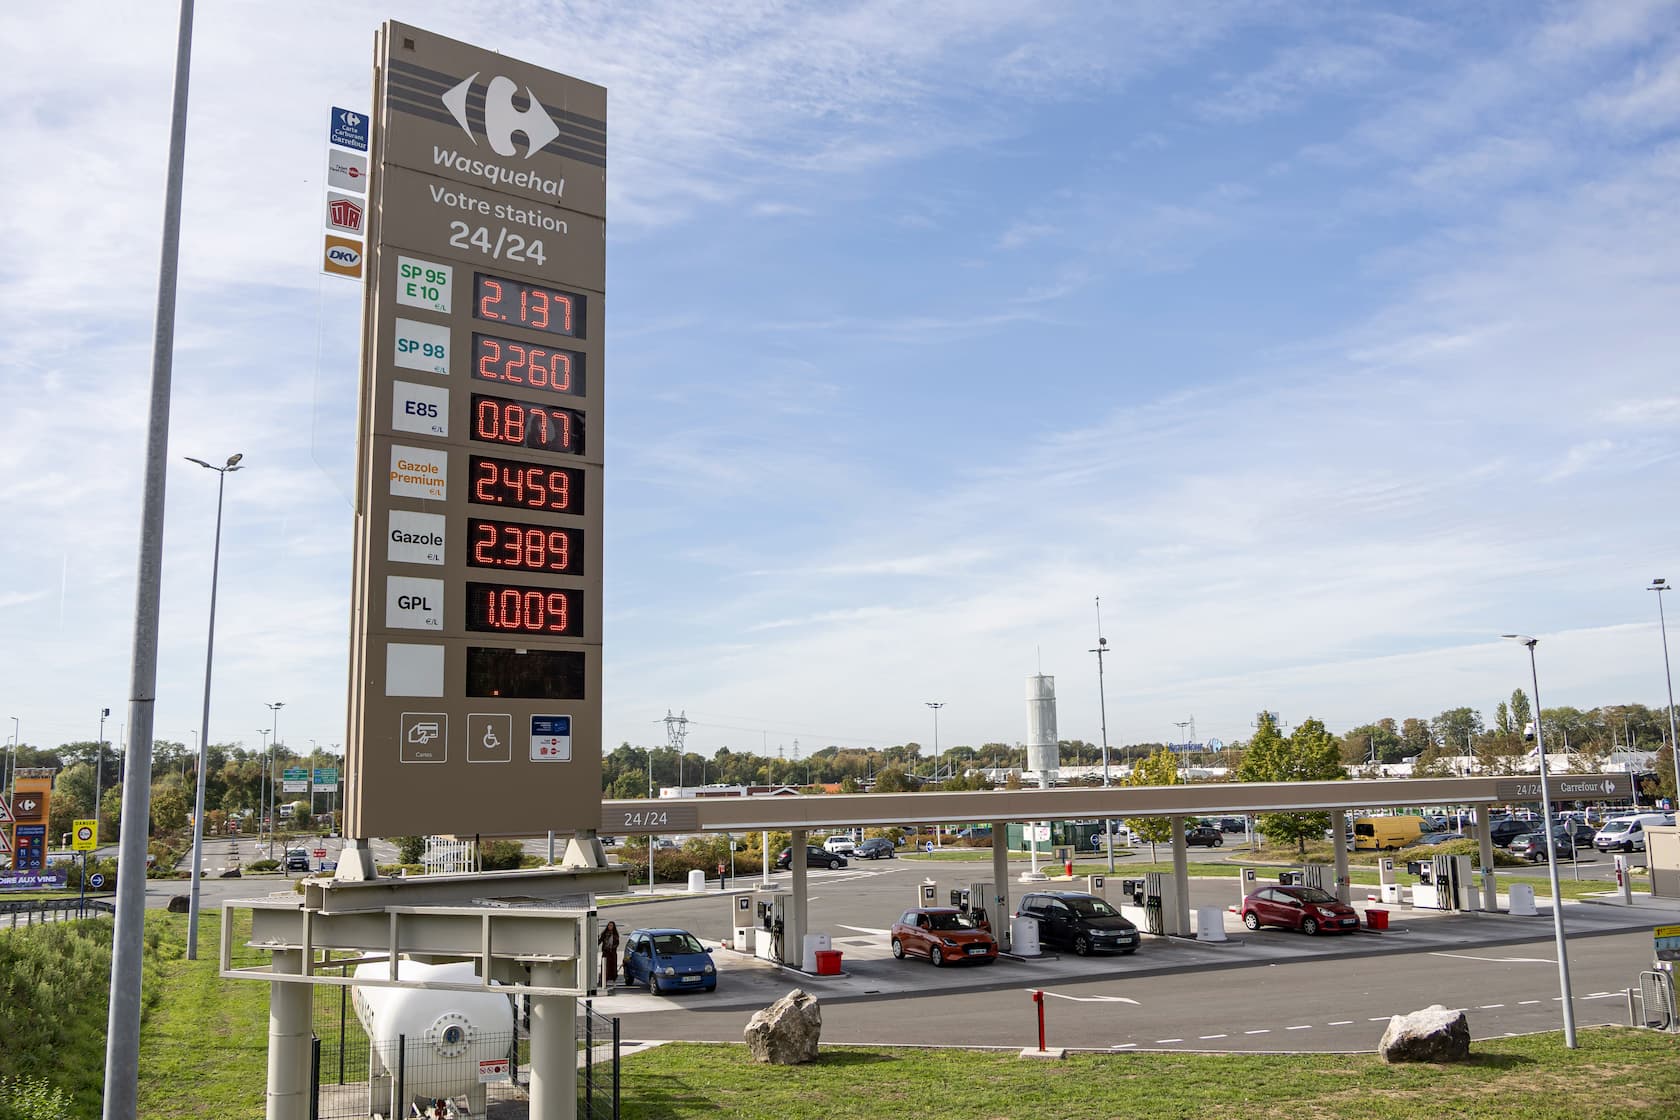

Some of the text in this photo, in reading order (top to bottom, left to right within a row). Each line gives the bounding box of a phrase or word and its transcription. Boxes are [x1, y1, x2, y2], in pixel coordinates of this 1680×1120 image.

[342, 125, 358, 133] Carte
[332, 135, 366, 149] Carrefour
[433, 146, 565, 197] Wasquehal
[330, 203, 361, 230] UTA
[429, 184, 568, 234] Votre station
[450, 221, 547, 265] 24/24
[329, 250, 358, 262] DKV
[400, 264, 446, 285] SP 95
[406, 283, 439, 301] E 10
[481, 280, 571, 331] 2.137
[398, 339, 445, 359] SP 98
[480, 340, 570, 391] 2.260
[405, 400, 438, 417] E85
[478, 400, 569, 448] 0.877
[397, 460, 439, 474] Gazole
[390, 471, 445, 487] Premium
[476, 462, 569, 509] 2.459
[391, 530, 443, 546] Gazole
[475, 524, 568, 569] 2.389
[398, 596, 432, 611] GPL
[489, 589, 567, 631] 1.009
[1516, 785, 1542, 795] 24/24
[1560, 782, 1598, 793] Carrefour
[624, 811, 668, 826] 24/24
[37, 875, 57, 883] VINS
